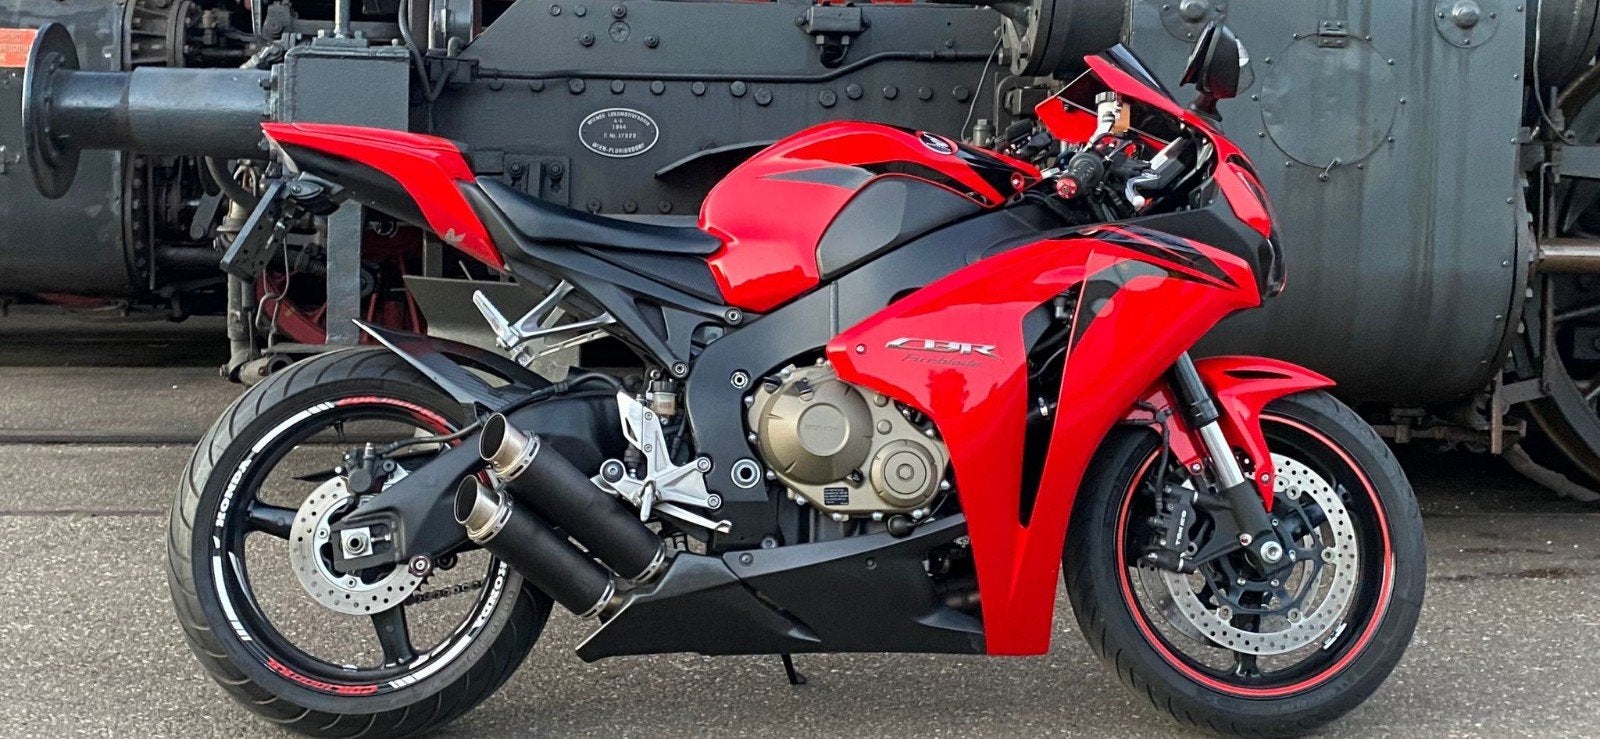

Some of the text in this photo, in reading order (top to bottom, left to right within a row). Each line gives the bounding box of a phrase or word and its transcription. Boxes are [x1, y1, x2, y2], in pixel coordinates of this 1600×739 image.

[885, 337, 1003, 361] CBR
[901, 354, 981, 368] Fireblade
[215, 459, 252, 527] HONDA
[472, 561, 508, 629] HONDA
